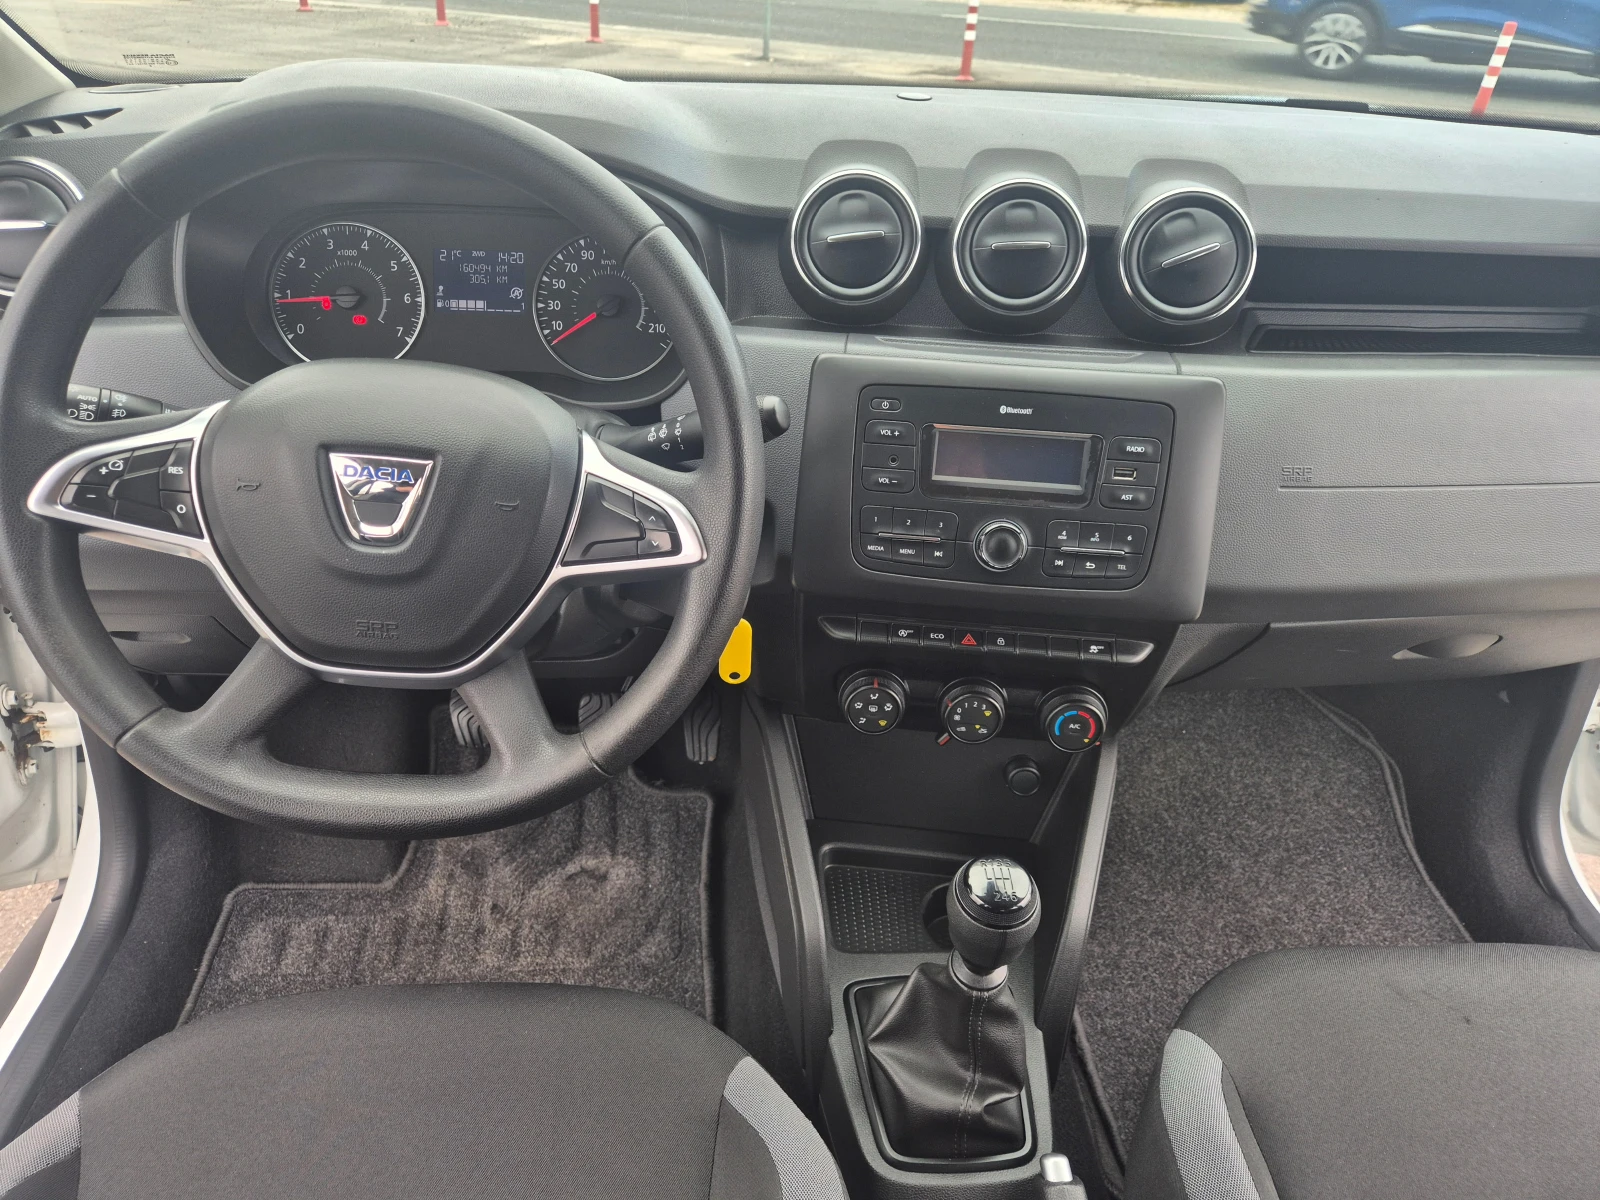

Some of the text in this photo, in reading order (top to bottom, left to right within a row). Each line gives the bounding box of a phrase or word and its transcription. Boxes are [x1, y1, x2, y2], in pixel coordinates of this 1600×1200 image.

[327, 239, 334, 249] 3
[360, 240, 369, 250] 4
[580, 250, 594, 260] 90
[299, 258, 306, 268] 2
[390, 260, 398, 271] 5
[564, 262, 578, 272] 70
[460, 264, 491, 273] 160494
[552, 279, 566, 289] 50
[404, 293, 411, 303] 6
[547, 300, 561, 310] 30
[297, 324, 304, 334] 0
[551, 321, 563, 330] 10
[648, 323, 666, 333] 210
[396, 327, 404, 337] 7
[168, 466, 184, 474] RES
[344, 464, 414, 483] DACIA
